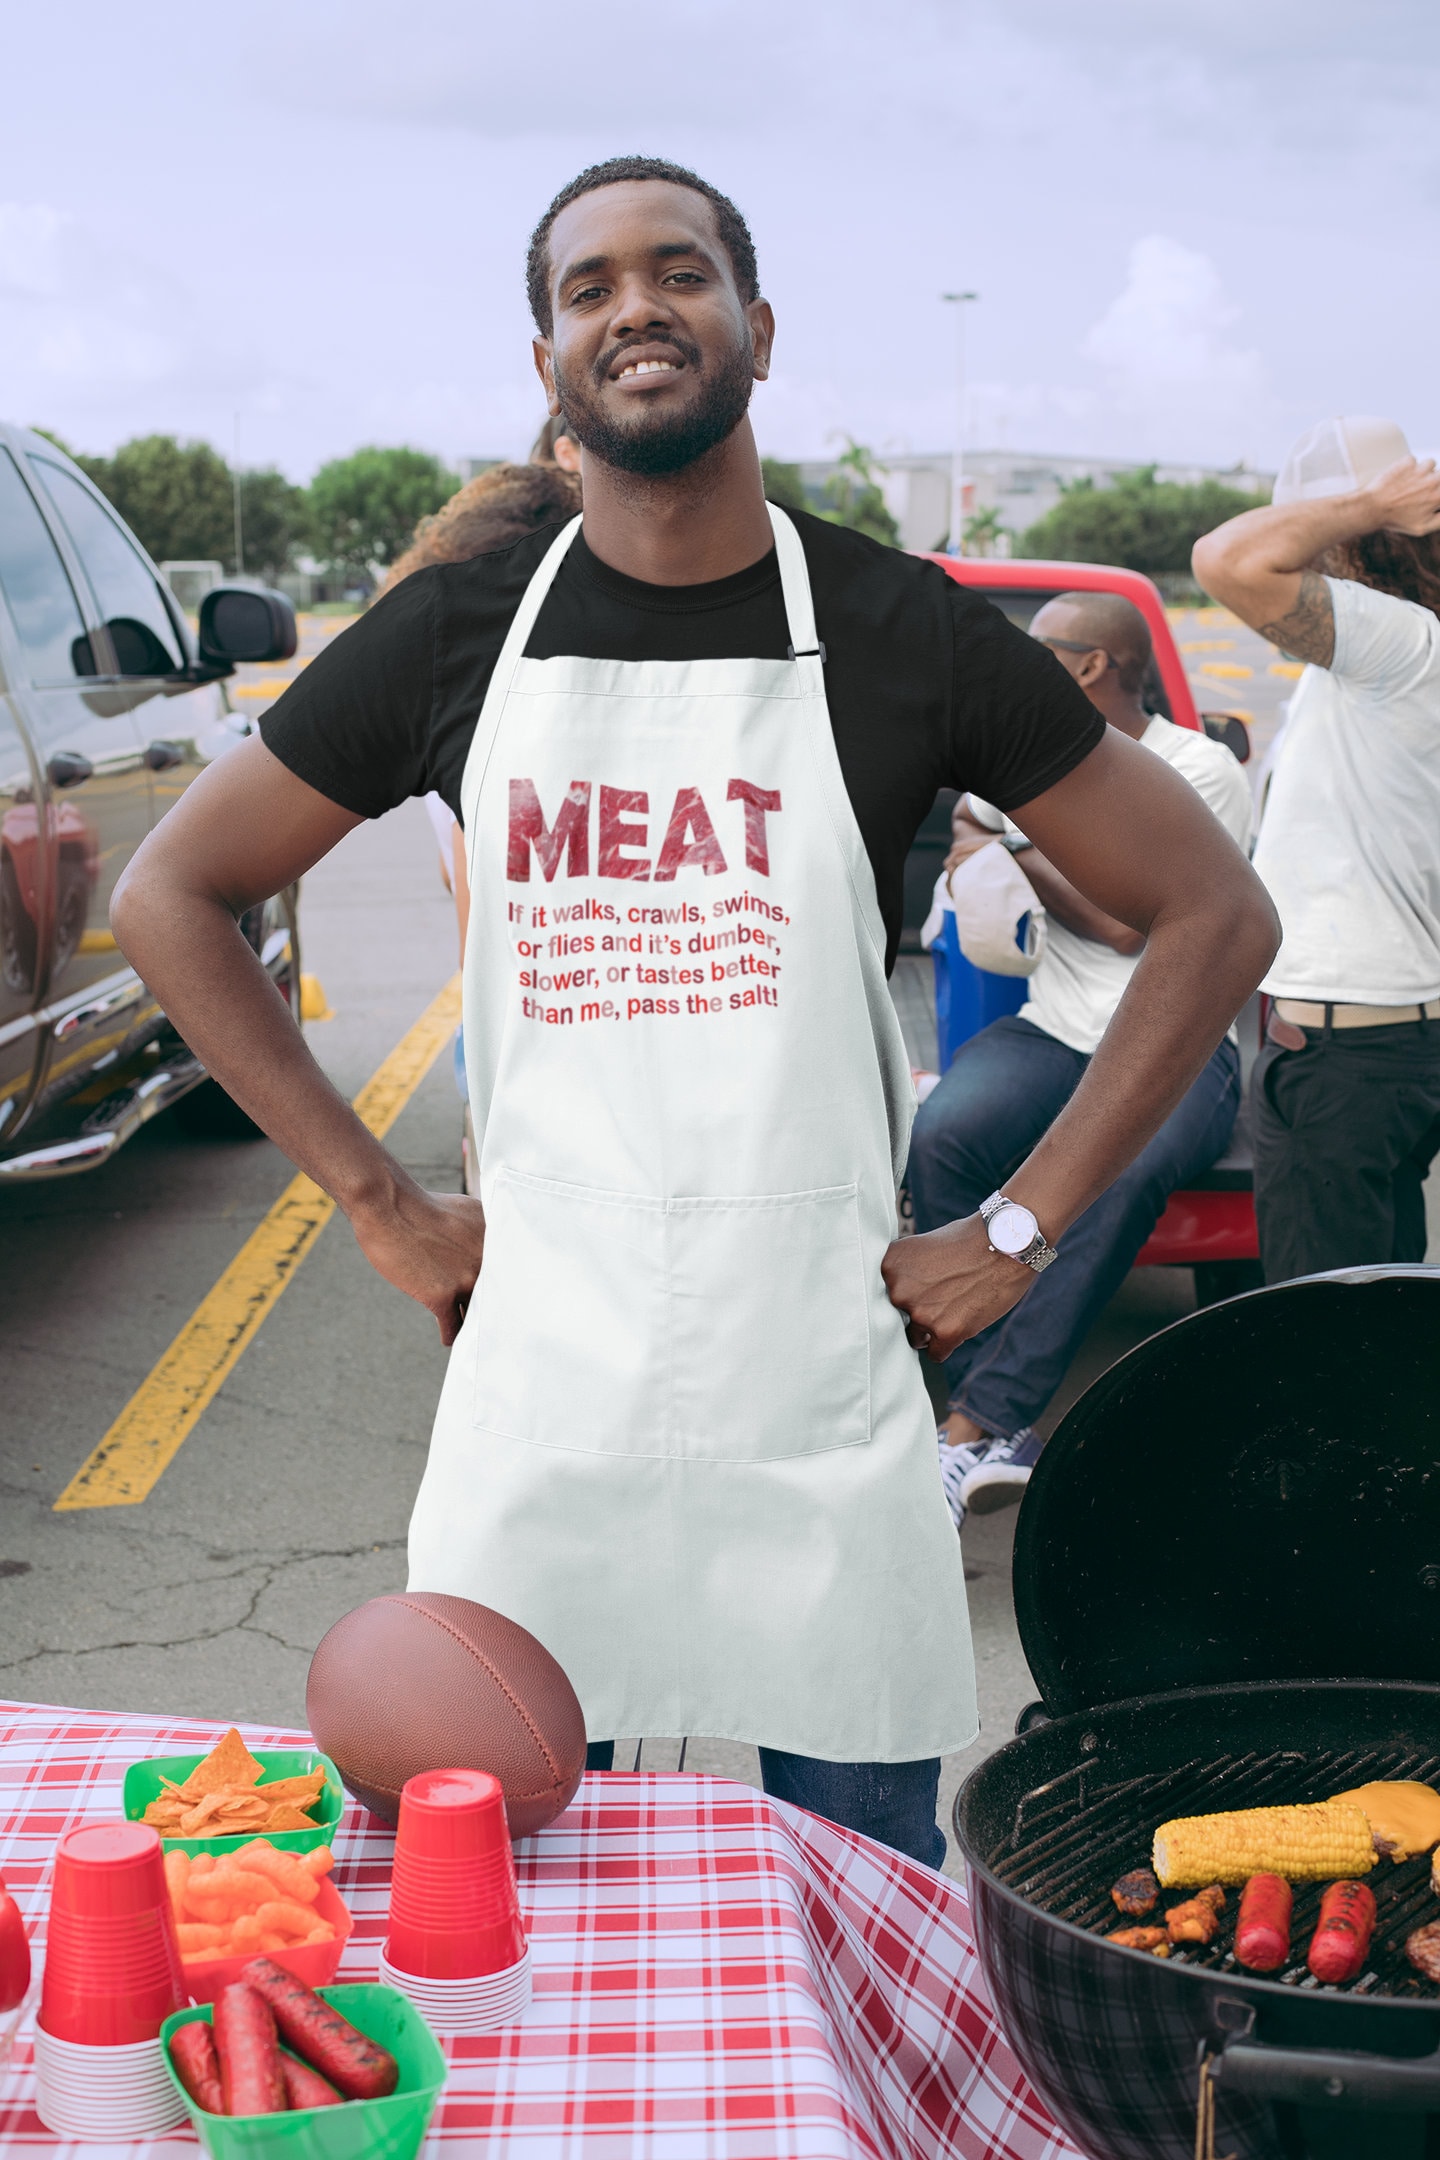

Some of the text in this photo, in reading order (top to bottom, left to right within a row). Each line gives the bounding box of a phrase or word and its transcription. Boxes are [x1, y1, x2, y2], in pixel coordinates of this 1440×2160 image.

[506, 778, 783, 883] MEAT
[508, 889, 791, 928] If it walks, crawls, swims,
[517, 940, 543, 960] or
[548, 932, 596, 960] flies
[601, 932, 643, 954] and
[687, 922, 782, 957] dumber,
[518, 953, 782, 992] slower, or tastes better
[521, 984, 779, 1025] than me, pass the salt!
